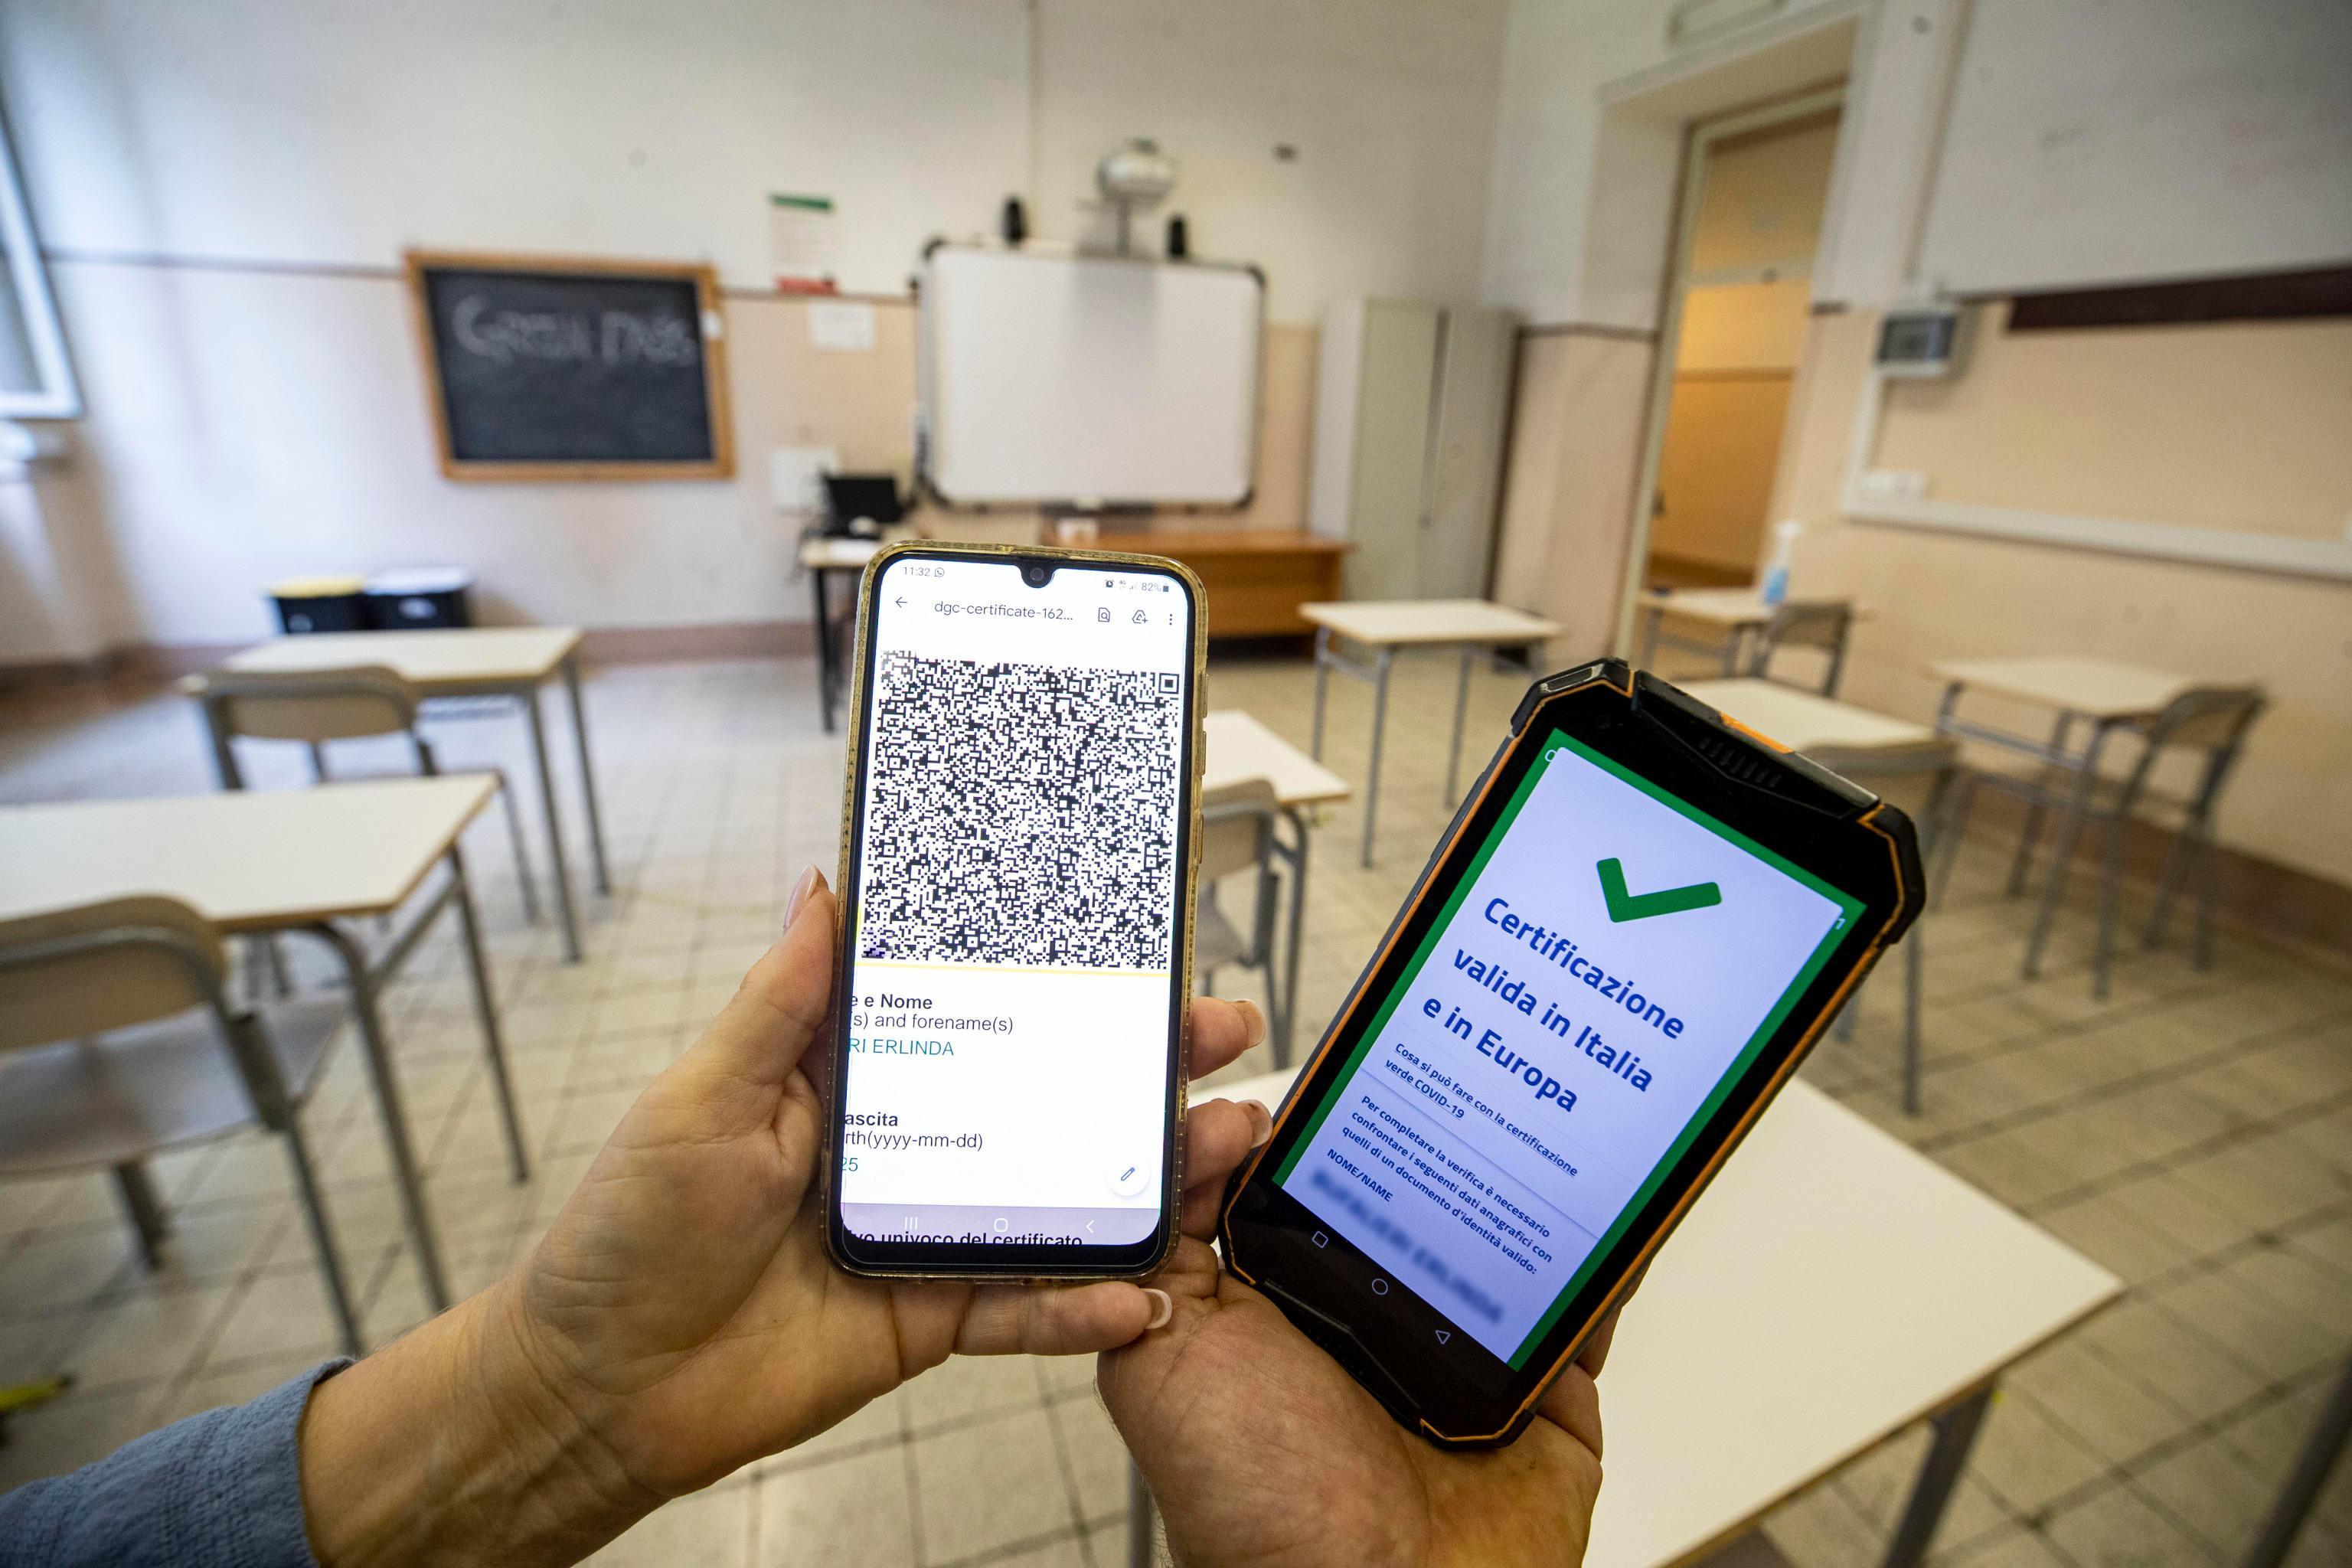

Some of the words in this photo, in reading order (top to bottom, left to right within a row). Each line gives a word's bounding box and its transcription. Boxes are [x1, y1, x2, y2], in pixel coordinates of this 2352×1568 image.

[903, 567, 931, 577] 11:32
[1141, 582, 1161, 593] 82%
[1484, 898, 1684, 1039] Certificazione
[864, 996, 874, 1008] e
[880, 994, 933, 1009] Nome
[875, 1014, 906, 1028] and
[913, 1014, 1014, 1034] forename(s)
[1454, 949, 1537, 1016] valida
[1540, 1002, 1571, 1037] in
[1574, 1025, 1652, 1092] Italia
[873, 1039, 955, 1056] ERLINDA
[1423, 998, 1442, 1018] e
[1444, 1005, 1473, 1040] in
[1475, 1028, 1578, 1112] Europa
[1385, 1060, 1414, 1083] verde
[1415, 1079, 1465, 1119] COVID-19
[1394, 1043, 1420, 1066] Cosa
[1421, 1061, 1431, 1073] si
[1429, 1070, 1452, 1087] può
[1451, 1083, 1474, 1103] fare
[1475, 1100, 1494, 1119] con
[1494, 1113, 1506, 1126] la
[1506, 1122, 1578, 1177] certificazione
[844, 1112, 898, 1126] ascita
[845, 1130, 983, 1152] rth(yyyy-mm-dd)
[1327, 1148, 1393, 1203] NOME/NAME
[1352, 1112, 1408, 1158] confrontare
[1414, 1157, 1459, 1194] seguenti
[1459, 1187, 1481, 1209] dati
[1479, 1205, 1533, 1249] anagrafici
[1533, 1243, 1553, 1263] con
[1361, 1096, 1380, 1113] Per
[1380, 1108, 1435, 1154] completare
[1436, 1150, 1446, 1163] la
[1447, 1158, 1485, 1191] verifica
[1485, 1187, 1494, 1197] è
[1494, 1191, 1550, 1239] necessario
[1342, 1126, 1370, 1150] quelli
[1370, 1145, 1382, 1158] di
[1381, 1156, 1395, 1171] un
[1396, 1165, 1452, 1211] documento
[1452, 1207, 1501, 1249] d'identità
[1502, 1243, 1538, 1276] valido:
